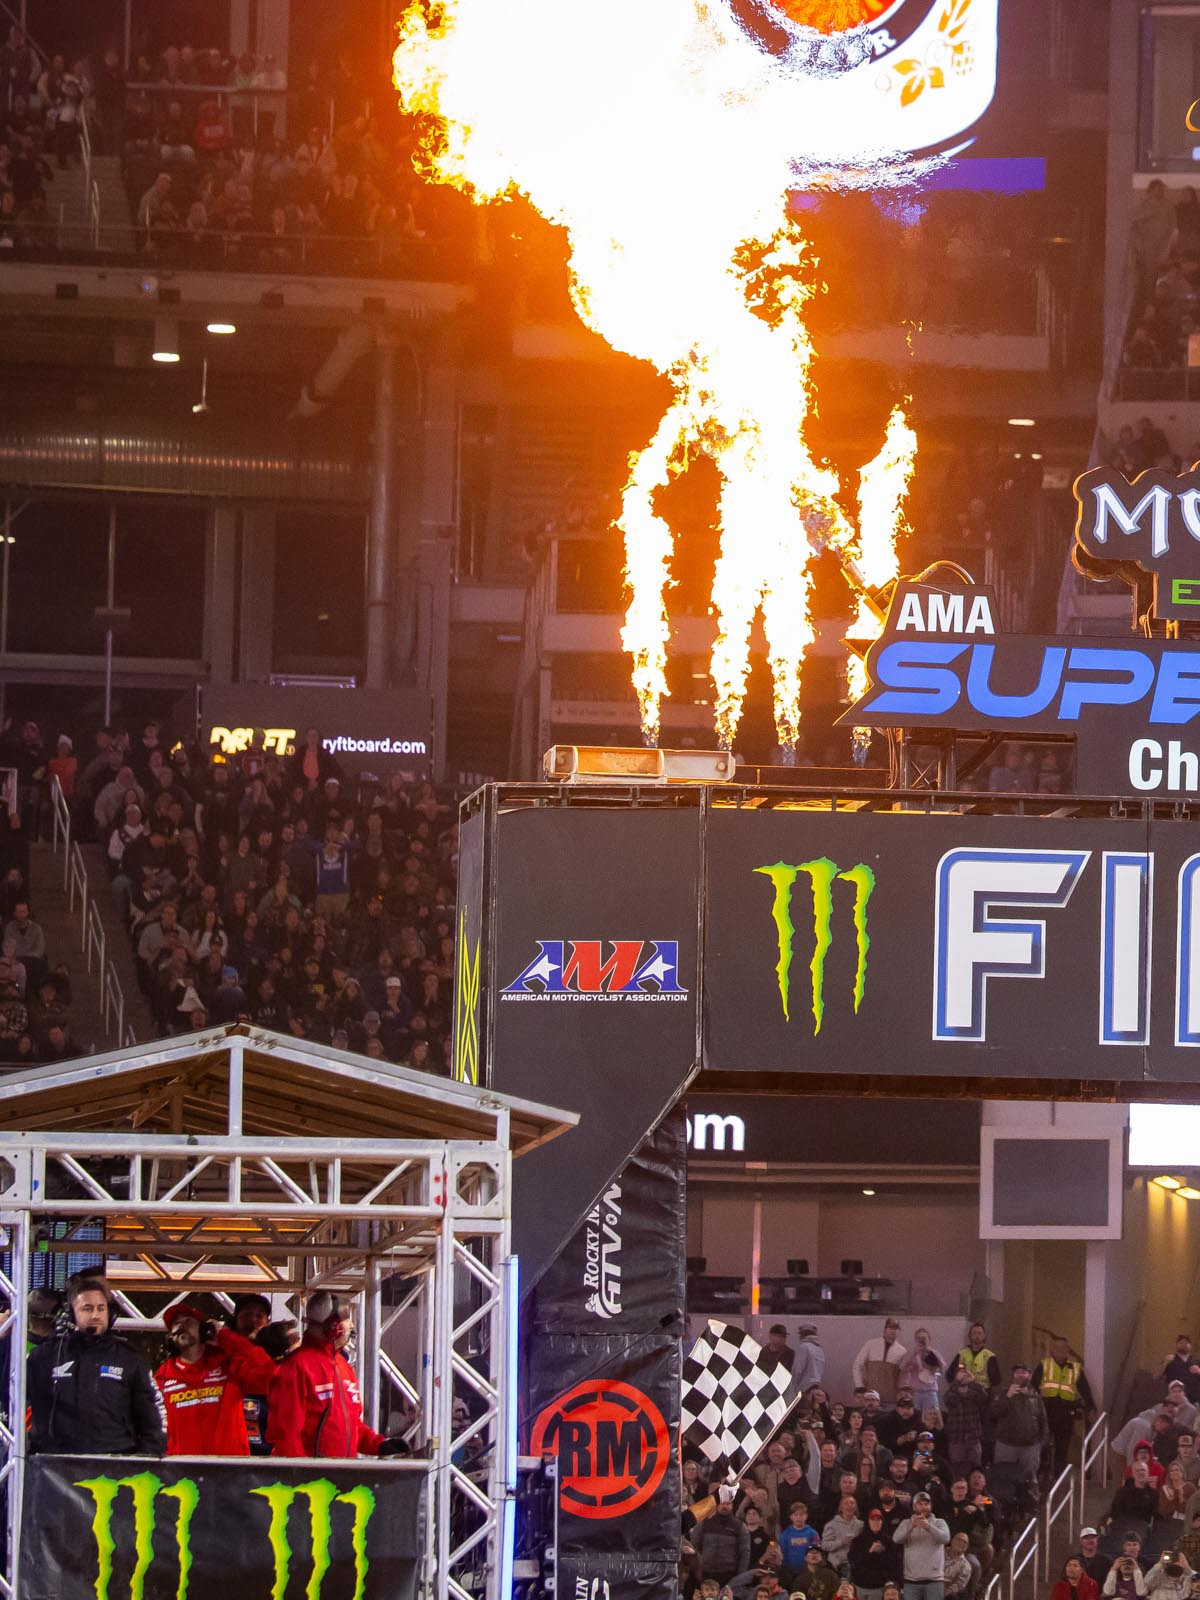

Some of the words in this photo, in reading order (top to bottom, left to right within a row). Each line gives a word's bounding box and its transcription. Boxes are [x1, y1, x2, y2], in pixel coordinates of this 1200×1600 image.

[896, 592, 995, 634] AMA
[322, 736, 426, 754] ryftboard.com
[499, 941, 689, 992] AMA
[501, 994, 550, 1002] AMERICAN
[552, 994, 624, 1002] MOTORCYCLIST
[626, 994, 688, 1002] ASSOCIATION
[583, 1227, 600, 1290] ROCKY
[559, 1420, 641, 1477] RM
